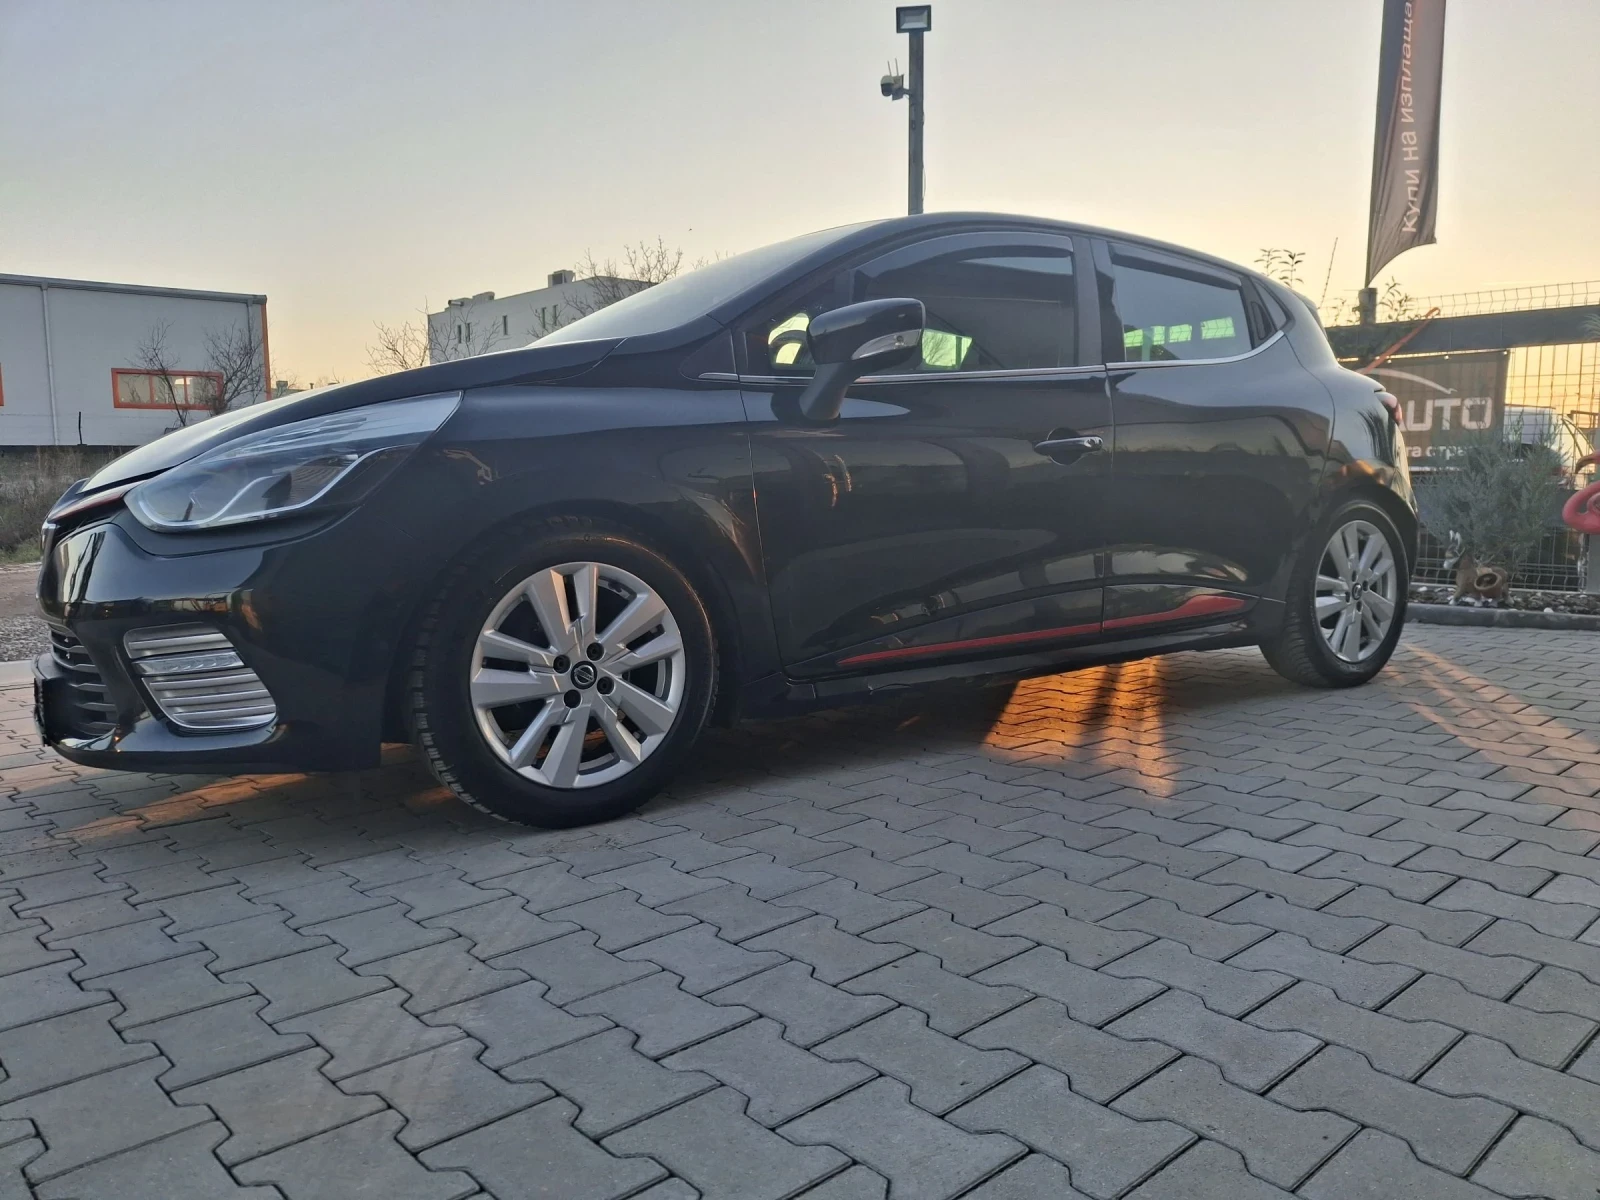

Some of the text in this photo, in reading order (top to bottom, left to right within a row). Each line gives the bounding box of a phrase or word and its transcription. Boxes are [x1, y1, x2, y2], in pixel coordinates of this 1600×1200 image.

[1401, 2, 1420, 232] Купи на изплаща
